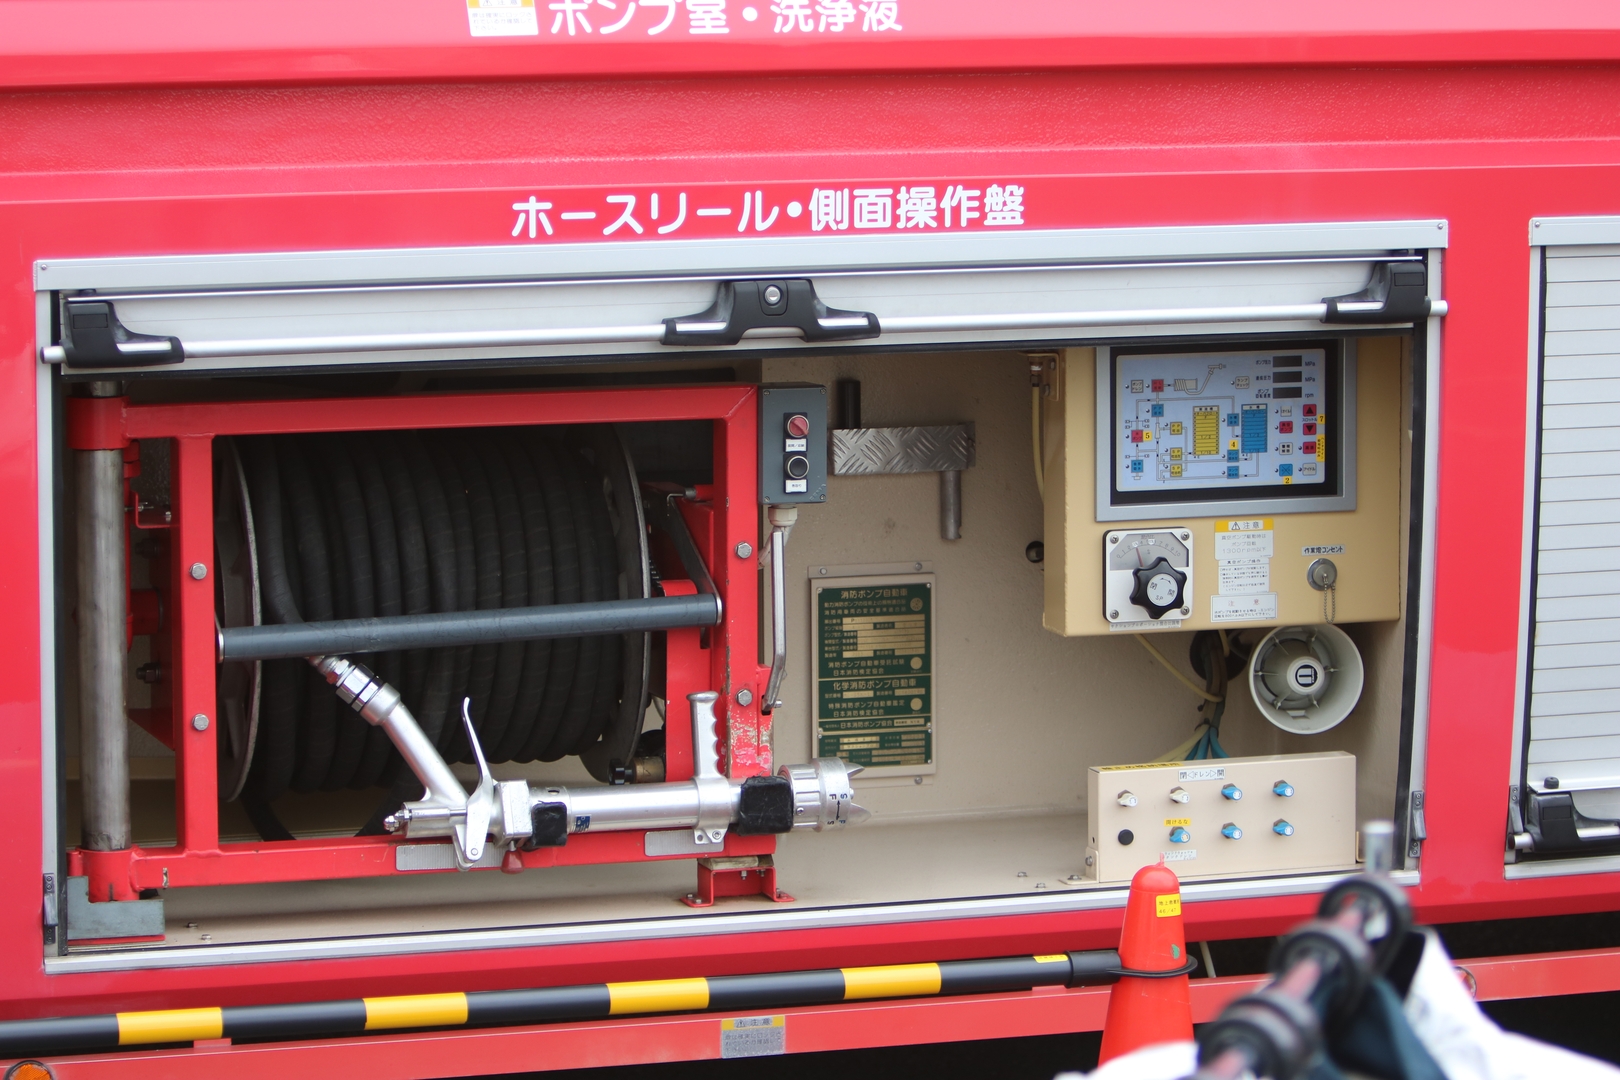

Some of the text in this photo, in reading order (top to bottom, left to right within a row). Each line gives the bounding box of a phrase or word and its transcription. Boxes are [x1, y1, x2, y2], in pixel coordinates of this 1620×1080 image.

[547, 0, 904, 36] ポンプ室・洗浄液
[511, 183, 1025, 239] ホースリール・側面操作盤
[1242, 521, 1260, 529] 注意
[840, 588, 908, 599] 消防ポンプ自動車
[833, 678, 916, 690] 化学消防ポンプ自動車
[840, 720, 892, 729] 日本消防ポンプ協会
[1180, 772, 1187, 780] 閉
[1217, 768, 1224, 777] 開
